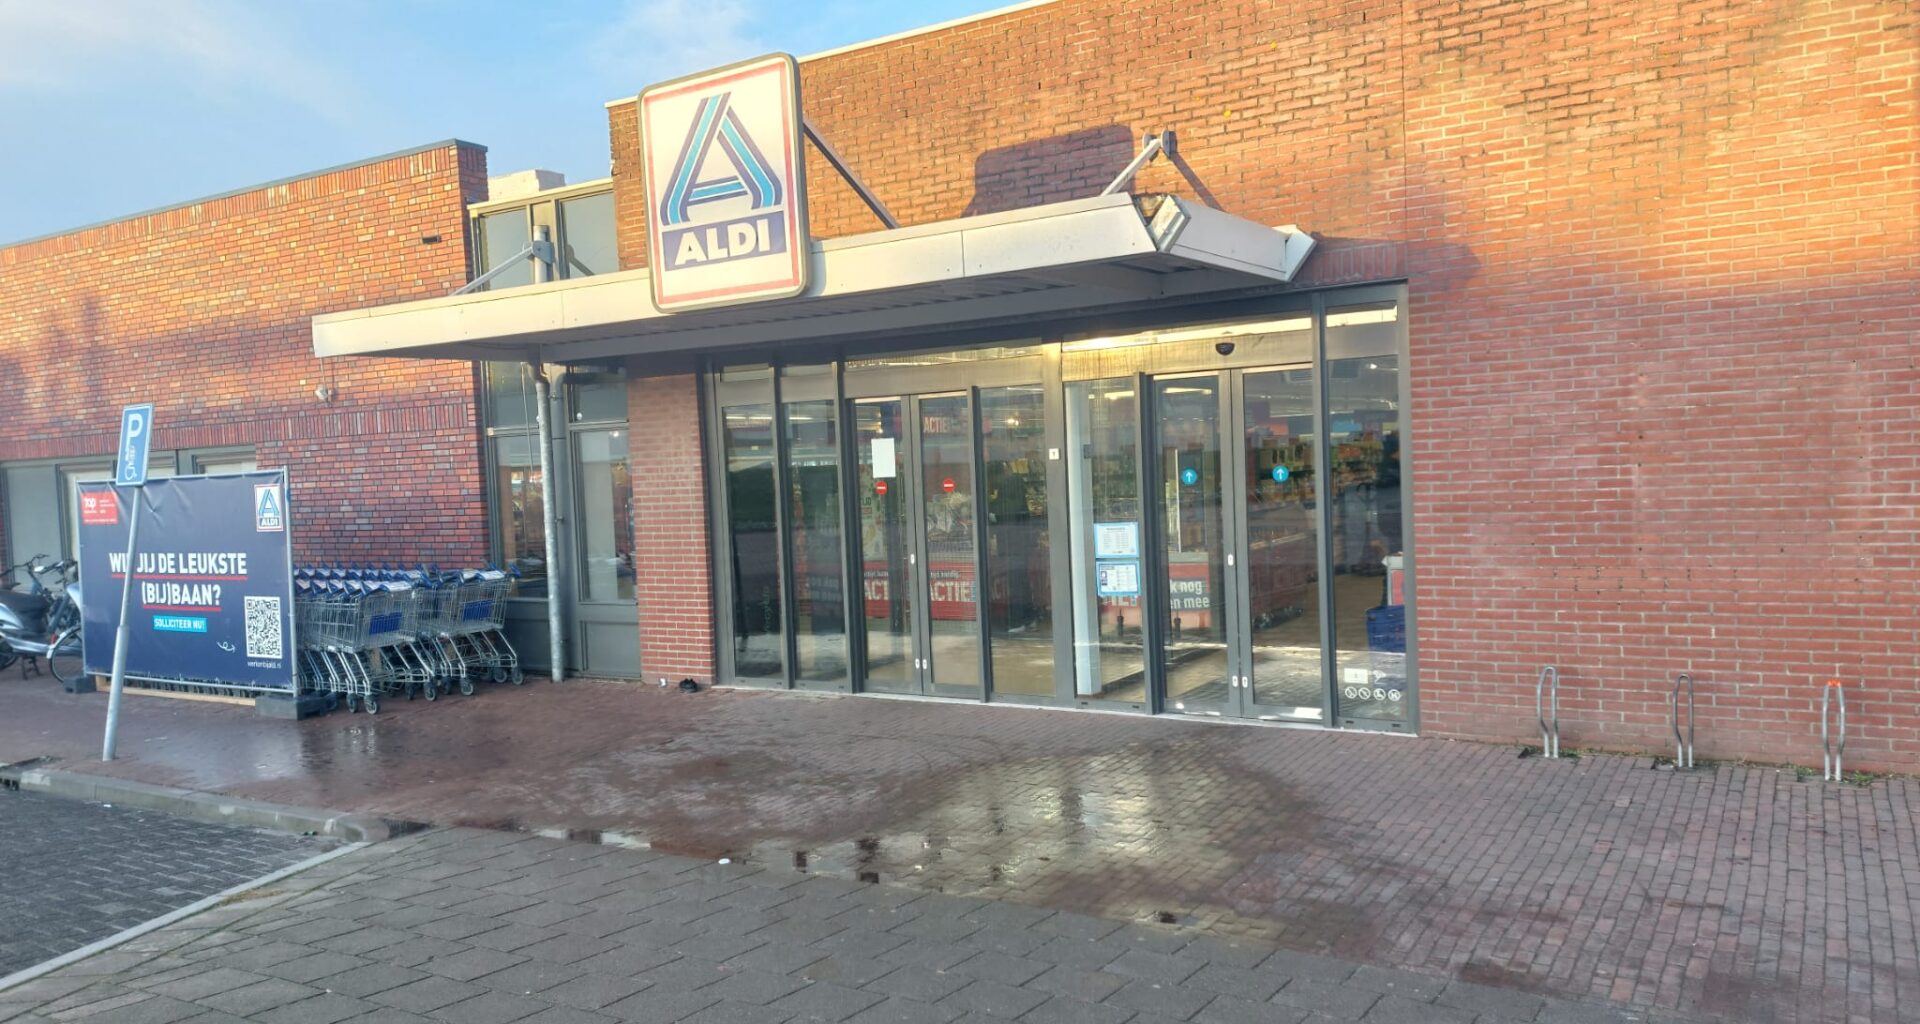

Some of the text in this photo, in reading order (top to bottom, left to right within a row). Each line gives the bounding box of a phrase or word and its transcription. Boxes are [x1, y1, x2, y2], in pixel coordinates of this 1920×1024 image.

[674, 218, 772, 266] ALDI
[125, 413, 144, 453] P
[261, 518, 278, 527] ALDI
[109, 552, 247, 575] WI JIJ DE LEUKSTE
[142, 581, 221, 606] (BIJ)BAAN?
[1180, 580, 1203, 595] nog
[1183, 596, 1209, 609] mee
[154, 617, 192, 629] SOLLICITEER
